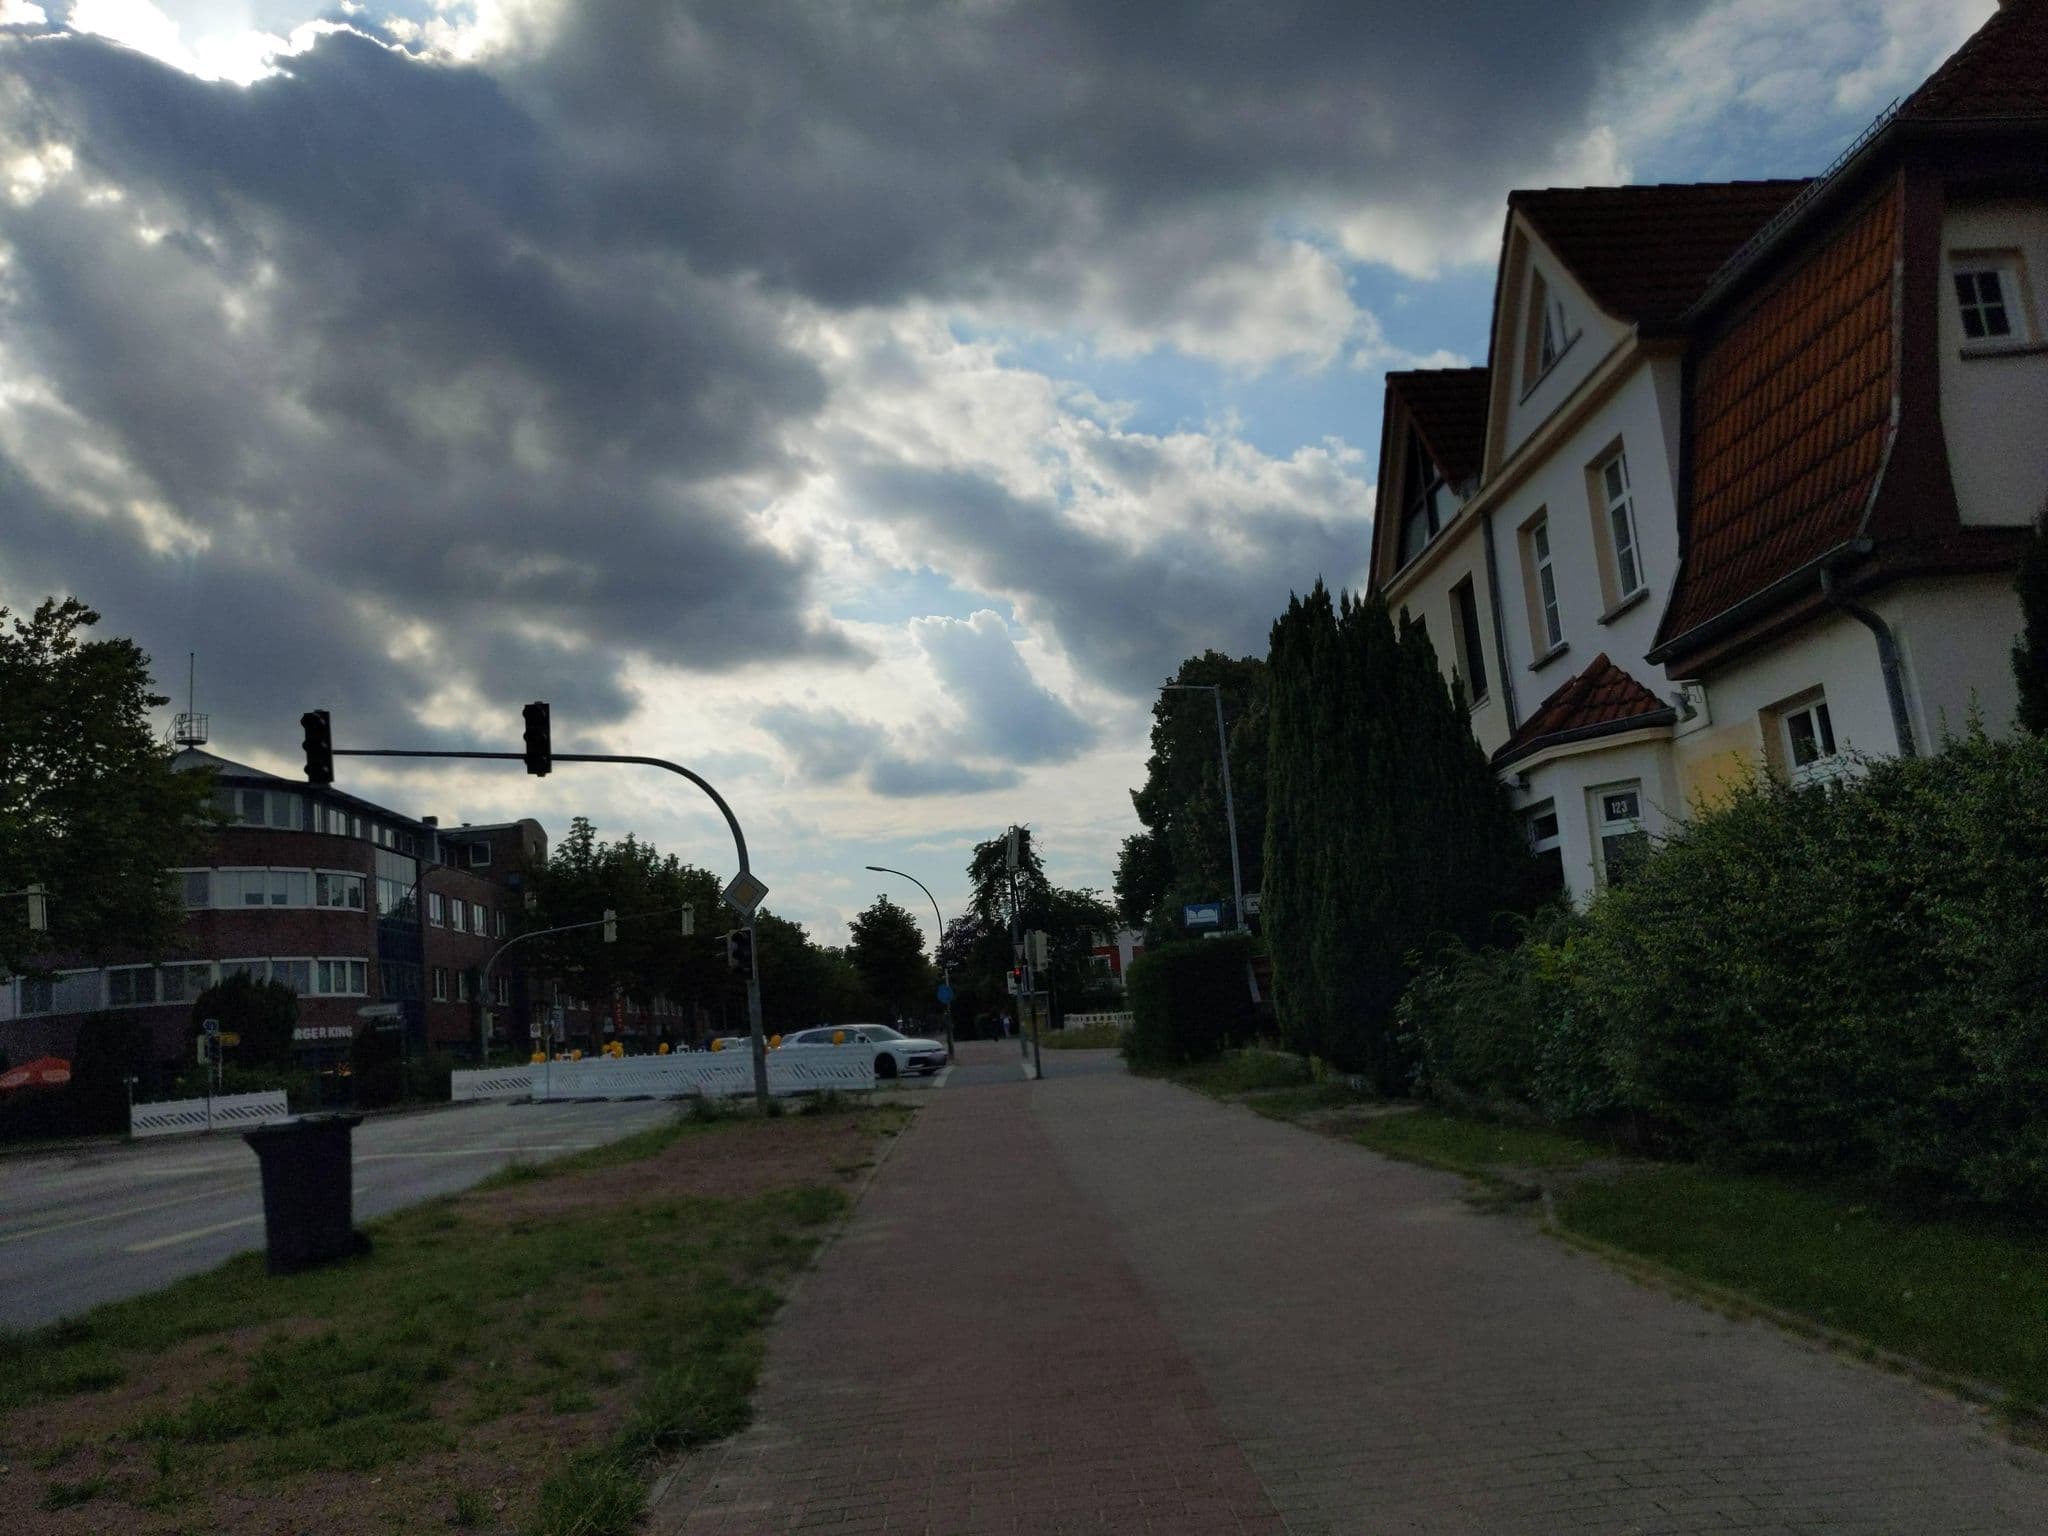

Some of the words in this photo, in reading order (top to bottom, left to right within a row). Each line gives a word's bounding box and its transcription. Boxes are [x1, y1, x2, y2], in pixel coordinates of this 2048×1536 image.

[1611, 800, 1628, 815] 123
[292, 1027, 327, 1040] RGER
[328, 1025, 353, 1038] KING
